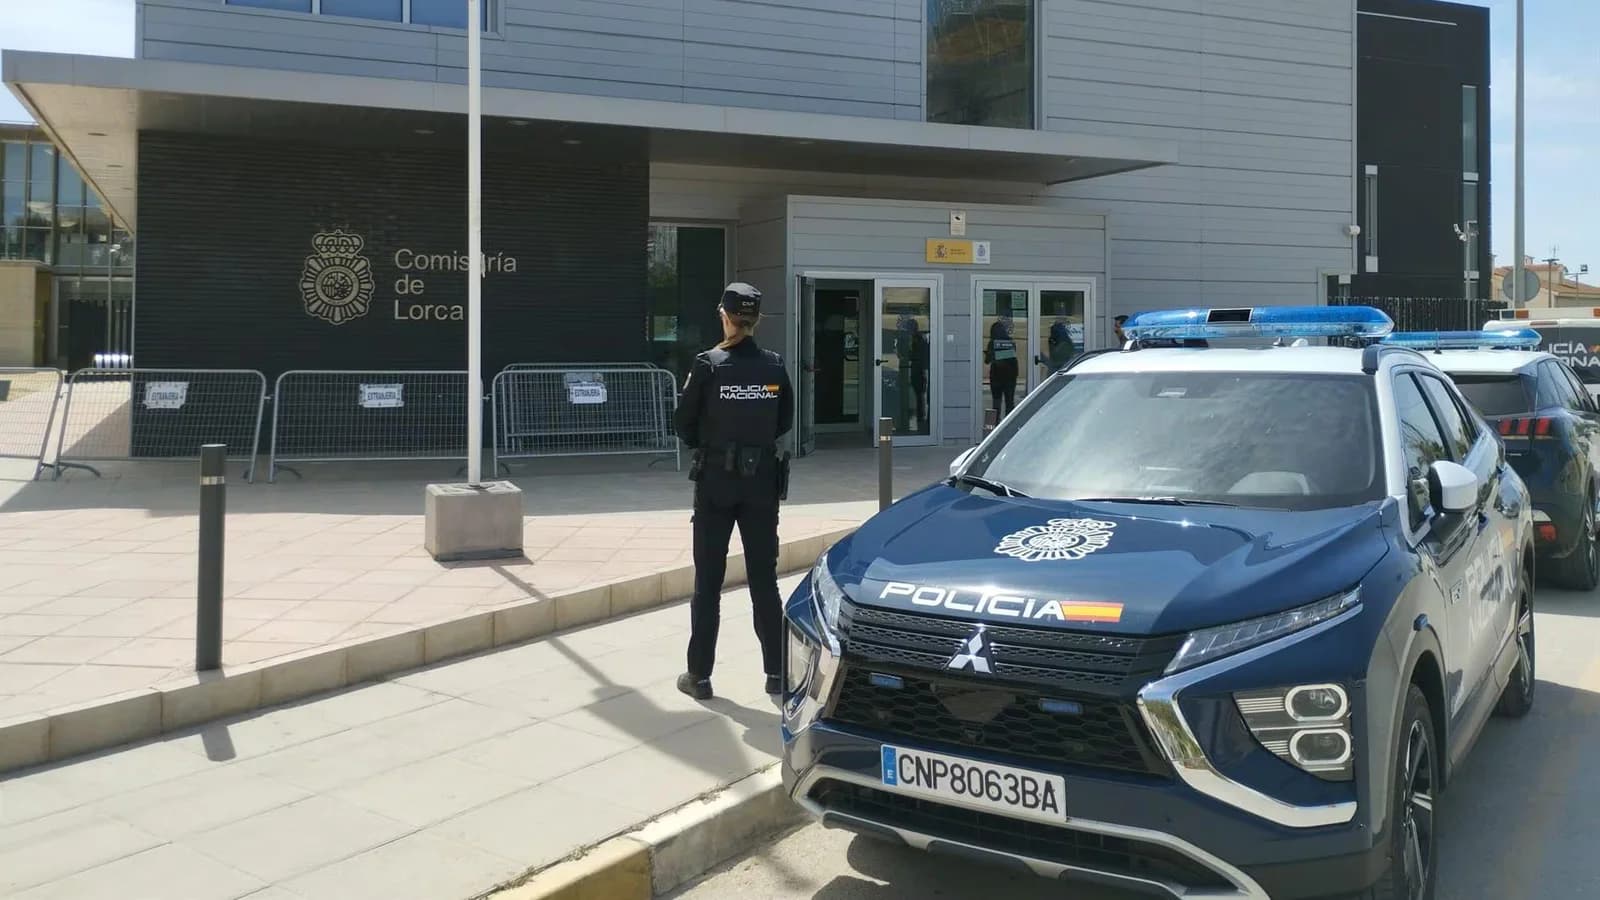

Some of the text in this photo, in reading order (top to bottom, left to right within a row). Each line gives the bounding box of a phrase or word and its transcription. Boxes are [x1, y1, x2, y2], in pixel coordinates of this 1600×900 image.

[394, 248, 517, 272] Comisría
[394, 274, 425, 294] de
[394, 299, 464, 320] Lorca
[720, 392, 778, 400] NACIONAL
[879, 581, 1065, 620] POLICIA
[887, 754, 1058, 814] E CNP8063BA
